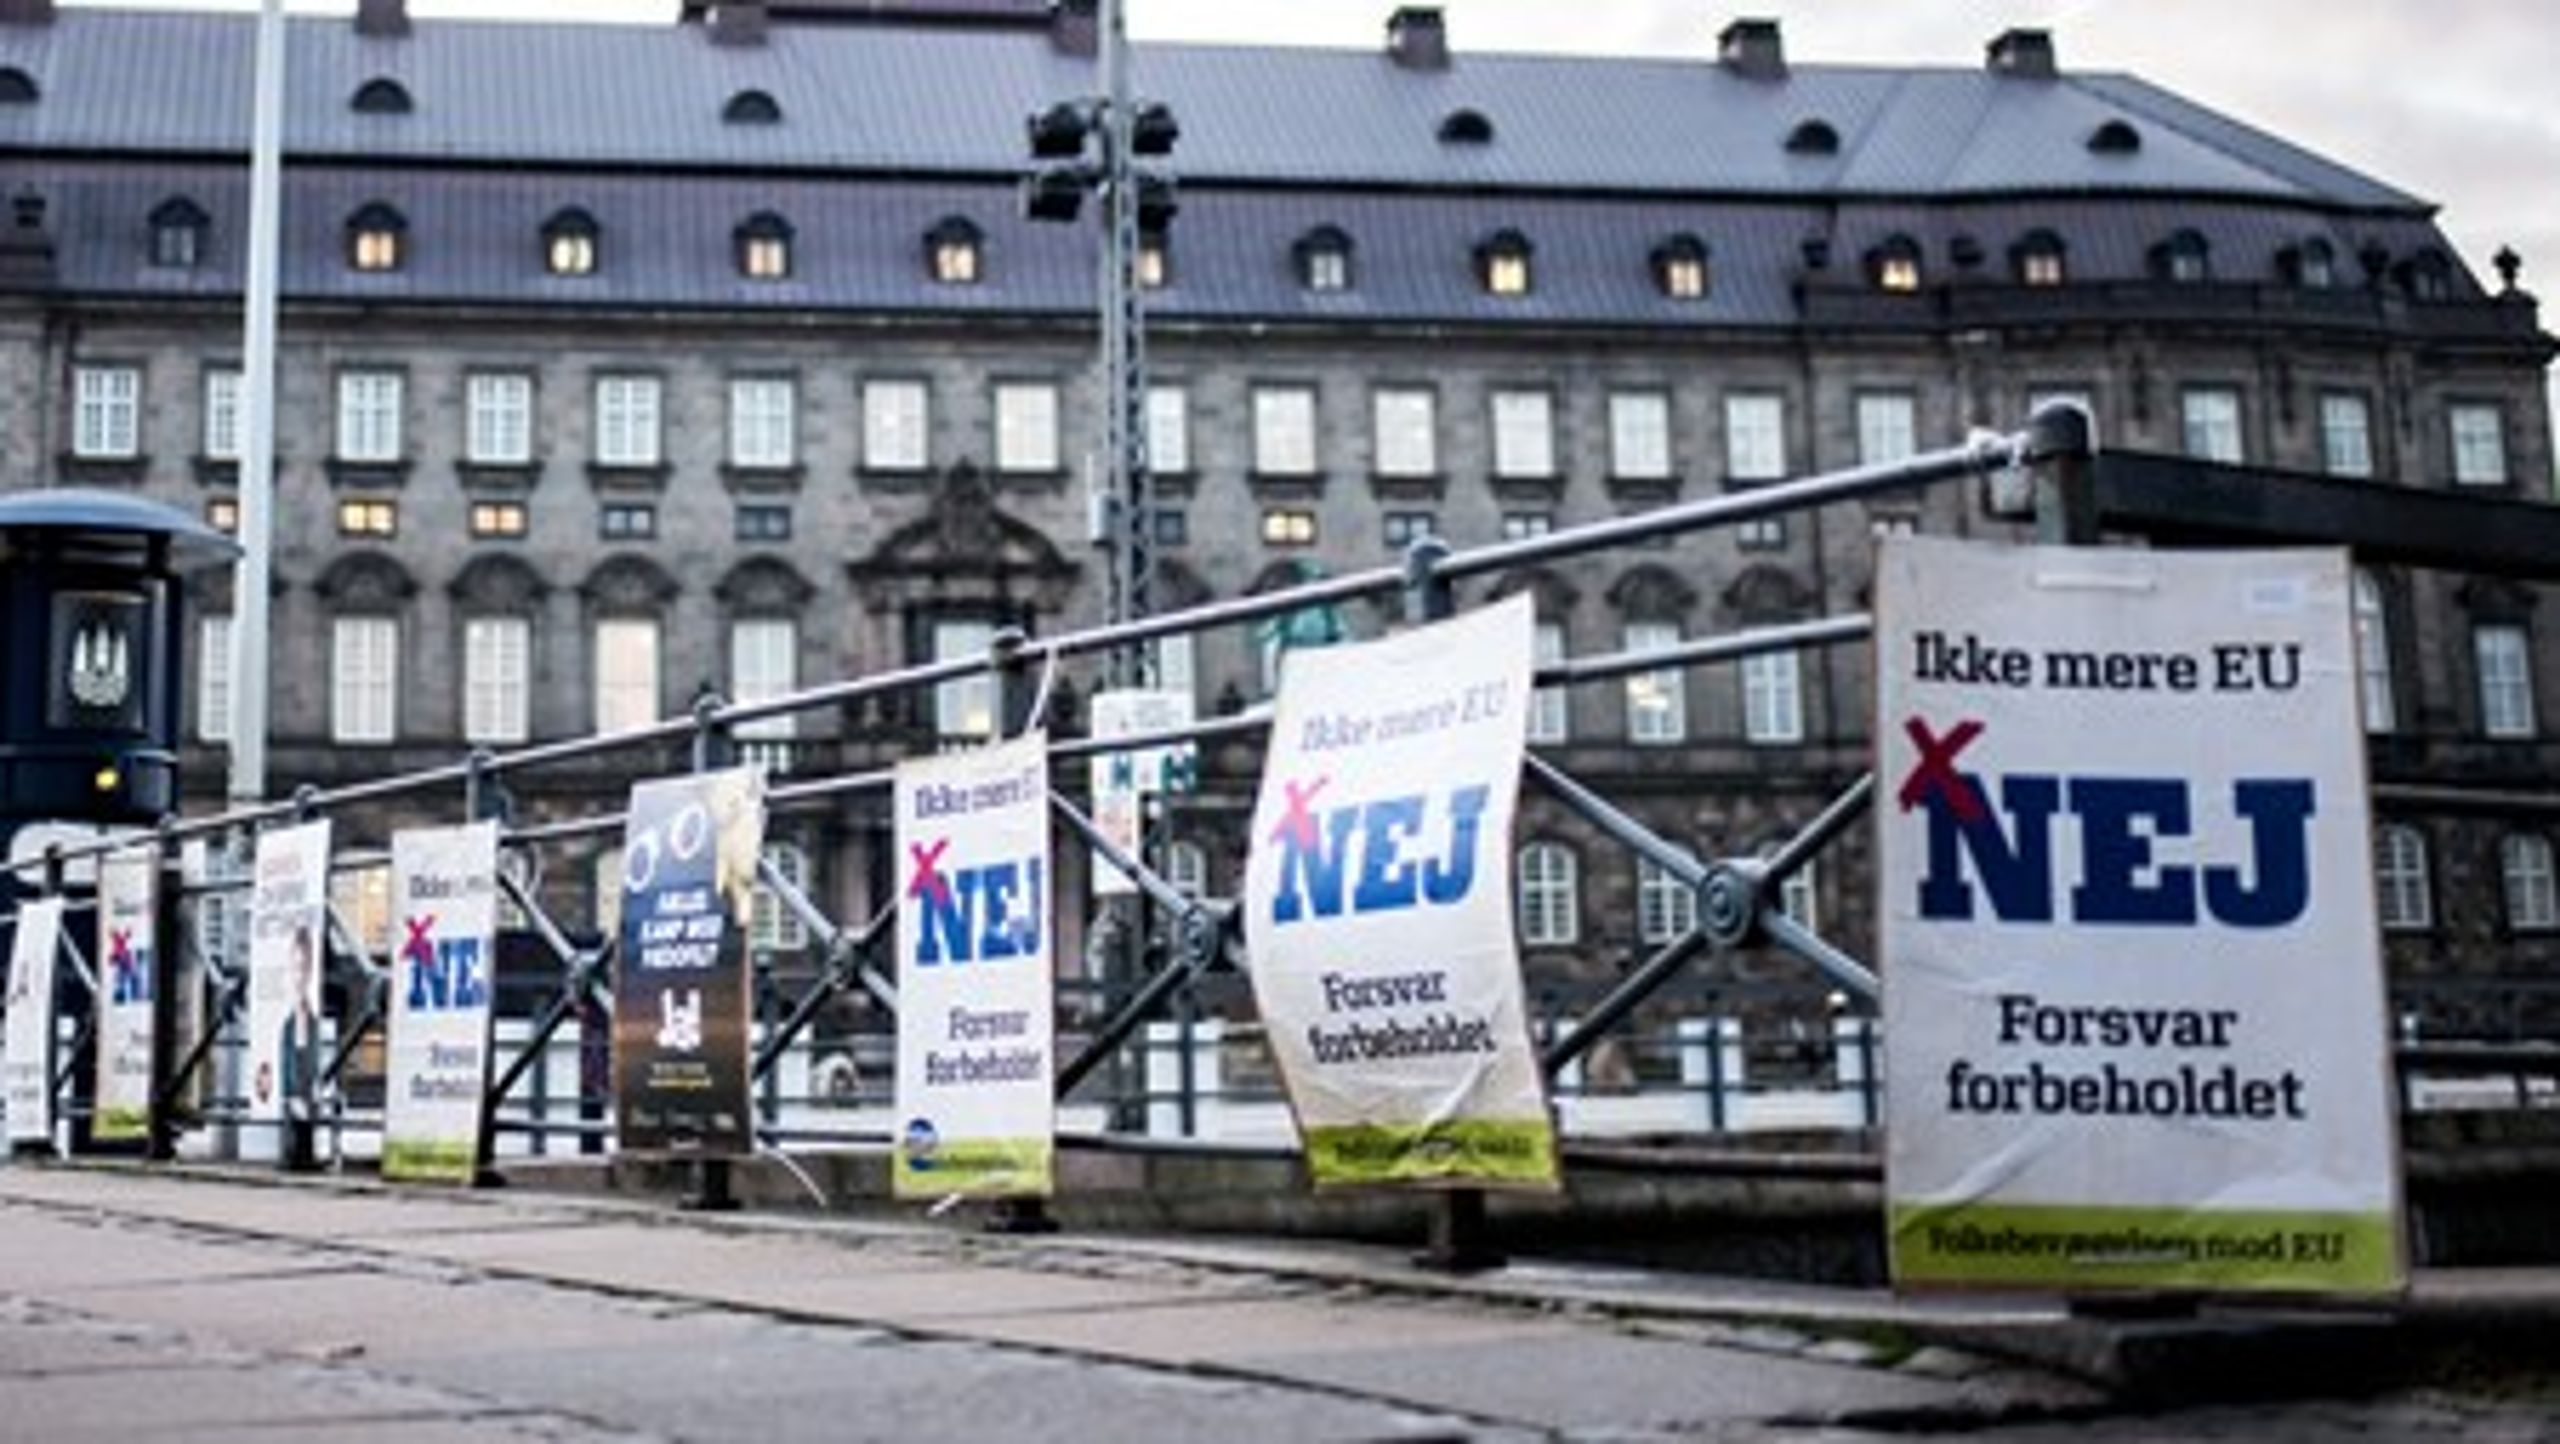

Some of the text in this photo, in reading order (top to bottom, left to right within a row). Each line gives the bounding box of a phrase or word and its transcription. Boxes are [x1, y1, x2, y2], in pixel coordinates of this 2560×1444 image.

[1914, 631, 2301, 692] Ikke mere EU
[1271, 783, 1492, 926] NEJ
[1917, 772, 2317, 929] NEJ
[915, 856, 1041, 968] NEJ
[1320, 971, 1447, 1012] Forsvar
[1307, 1013, 1498, 1065] forbeholdet
[1997, 995, 2239, 1048] Forsvar
[1946, 1061, 2307, 1120] forbeholdet
[2206, 1231, 2284, 1261] mod
[2291, 1231, 2347, 1263] EU
